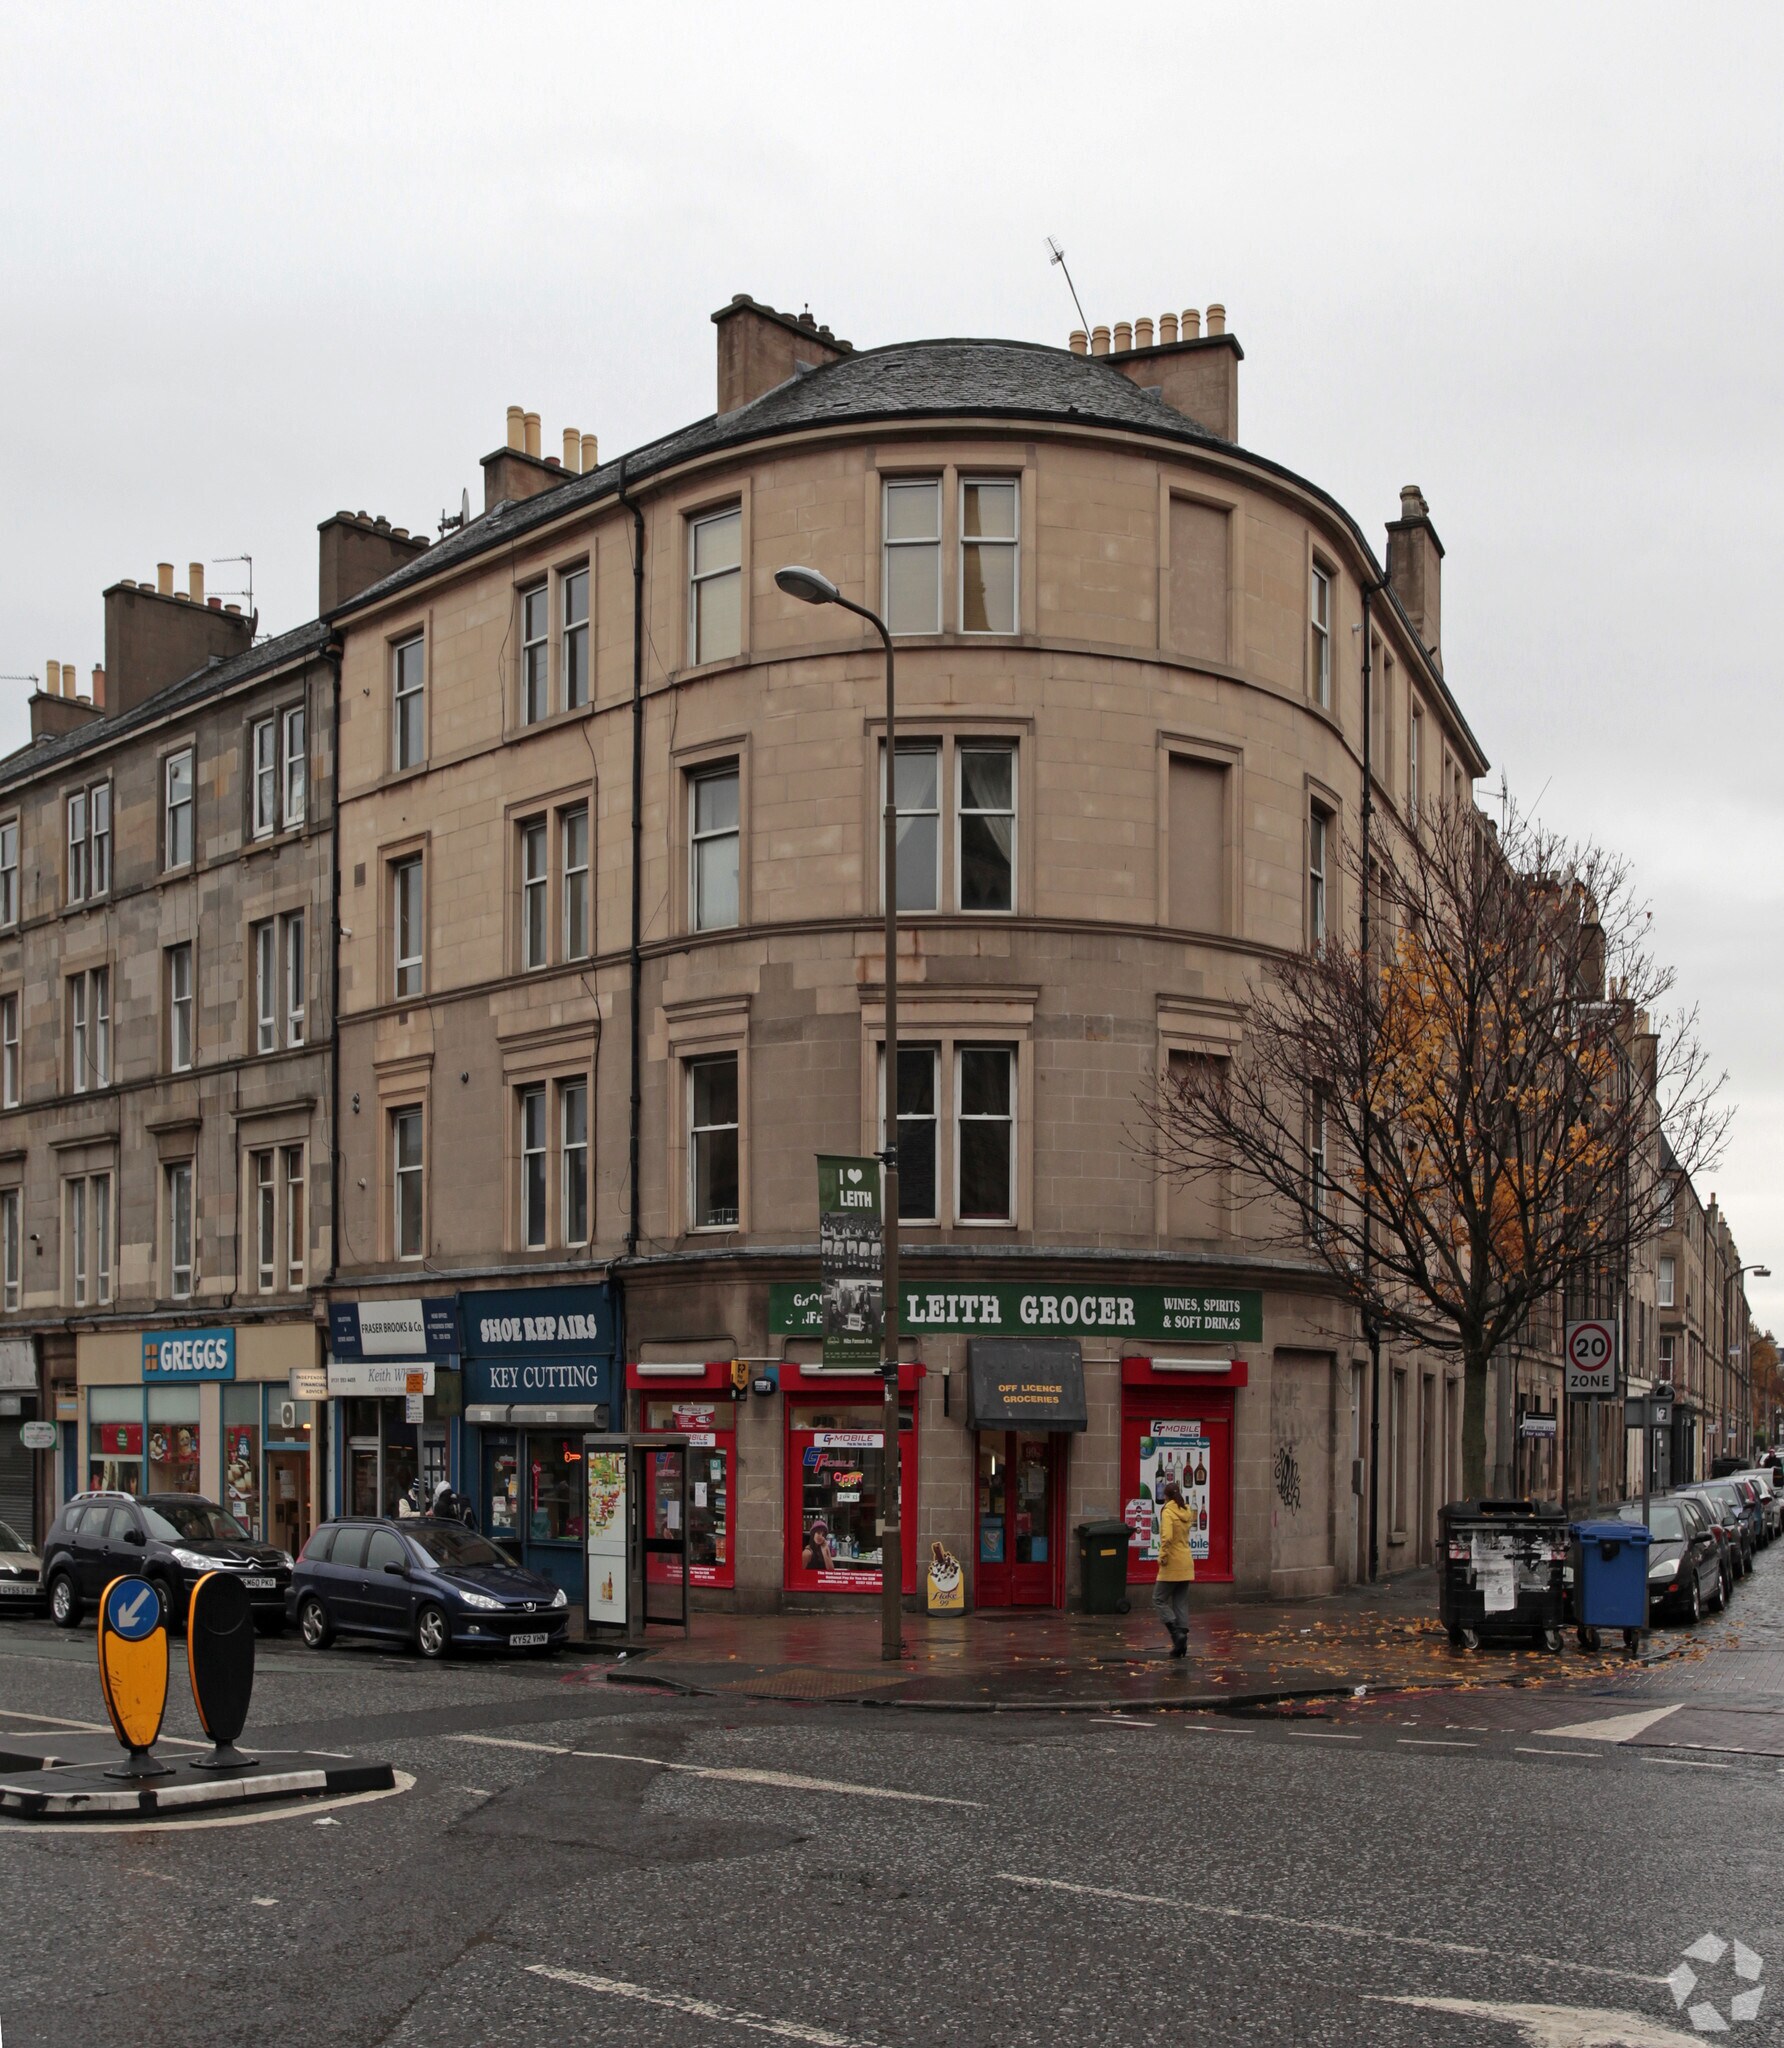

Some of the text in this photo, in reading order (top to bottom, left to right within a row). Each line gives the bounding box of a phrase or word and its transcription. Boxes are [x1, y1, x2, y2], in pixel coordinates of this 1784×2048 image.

[839, 1169, 844, 1184] I
[840, 1190, 872, 1207] LEITH
[906, 1295, 1136, 1325] LEITH GROCER
[1164, 1298, 1240, 1312] WINES, SPIRITS
[362, 1322, 423, 1334] FRASER BROOKS & Co.
[480, 1314, 597, 1342] SHOE REPAIRS
[1163, 1315, 1172, 1328] &
[1174, 1316, 1201, 1328] SOFT
[1576, 1338, 1605, 1357] 20
[160, 1339, 227, 1371] GREGGS
[368, 1368, 391, 1382] Keith
[490, 1365, 598, 1388] KEY CUTTING
[1571, 1375, 1609, 1387] ZONE
[1003, 1396, 1059, 1404] GROCERIES
[824, 1435, 833, 1445] GT
[803, 1447, 829, 1473] GT
[833, 1472, 862, 1485] Open
[931, 1592, 957, 1600] Flake
[512, 1634, 546, 1644] KY52 VHN
